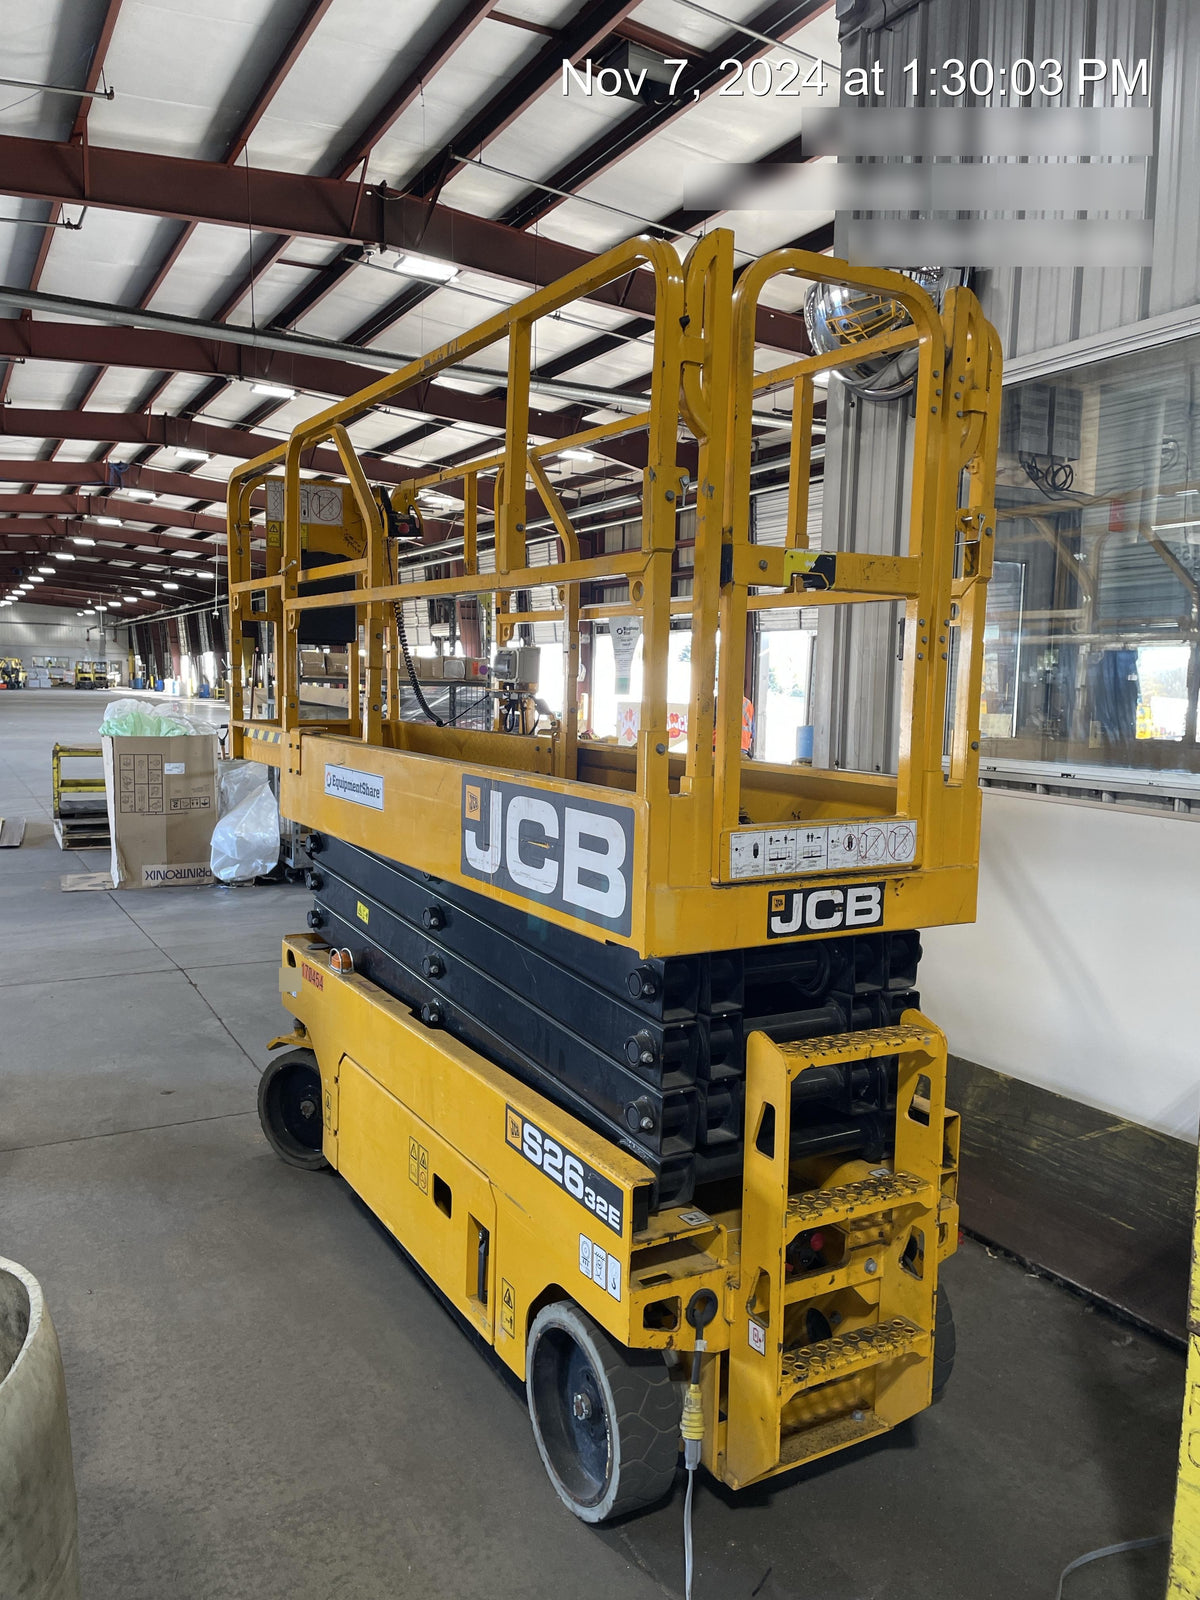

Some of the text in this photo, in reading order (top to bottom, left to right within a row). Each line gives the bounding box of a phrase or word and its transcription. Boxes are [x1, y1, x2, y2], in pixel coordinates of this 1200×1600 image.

[332, 774, 381, 799] EquipmentShare
[464, 789, 627, 919] JCB
[145, 866, 212, 881] PRINTRONIX
[770, 886, 881, 934] JCB
